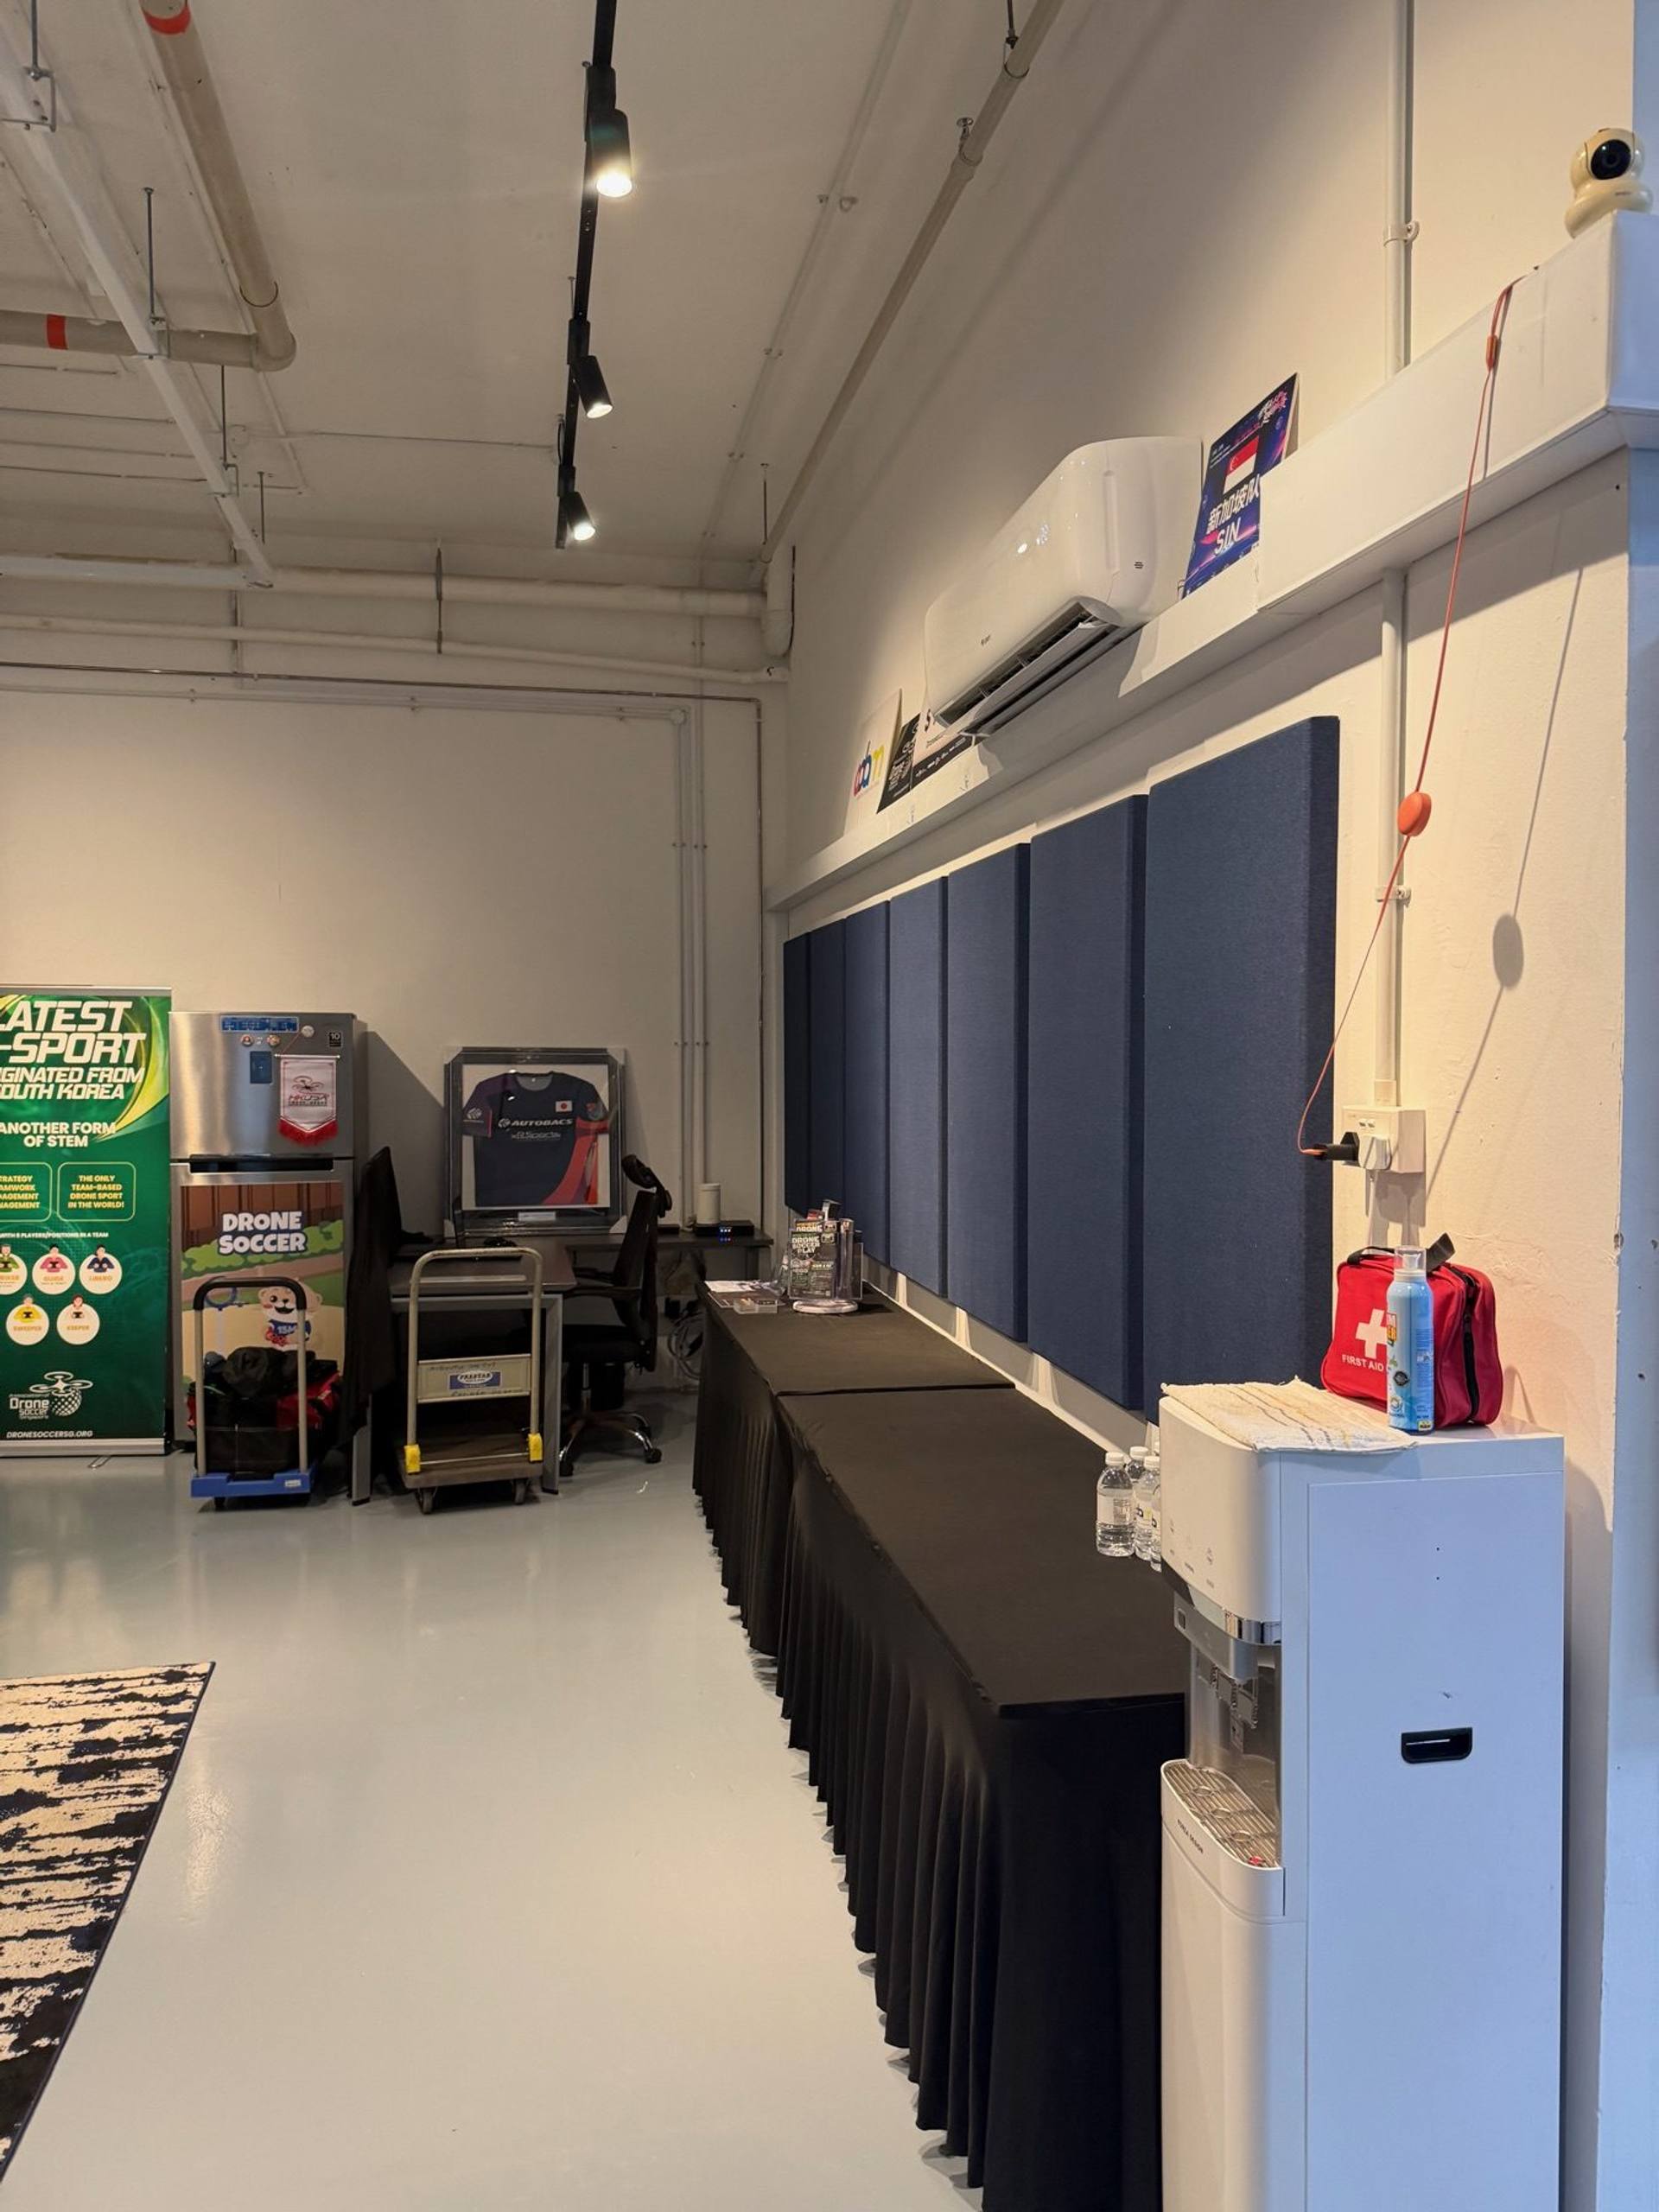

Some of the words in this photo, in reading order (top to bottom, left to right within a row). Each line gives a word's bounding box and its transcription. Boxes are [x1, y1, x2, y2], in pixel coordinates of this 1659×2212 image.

[1214, 517, 1242, 554] SIN
[0, 1067, 84, 1083] GINATED
[87, 1067, 145, 1083] FROM
[0, 1084, 54, 1099] OUTH
[57, 1084, 124, 1099] KOREA
[0, 1122, 70, 1135] ANOTHER
[73, 1122, 116, 1135] FORM
[23, 1135, 45, 1147] OF
[48, 1135, 88, 1147] STEM
[222, 1211, 302, 1231] DRONE
[219, 1233, 305, 1254] SOCCER
[1342, 1354, 1367, 1368] FIRST
[1368, 1360, 1384, 1372] AID
[10, 1398, 49, 1409] Drone
